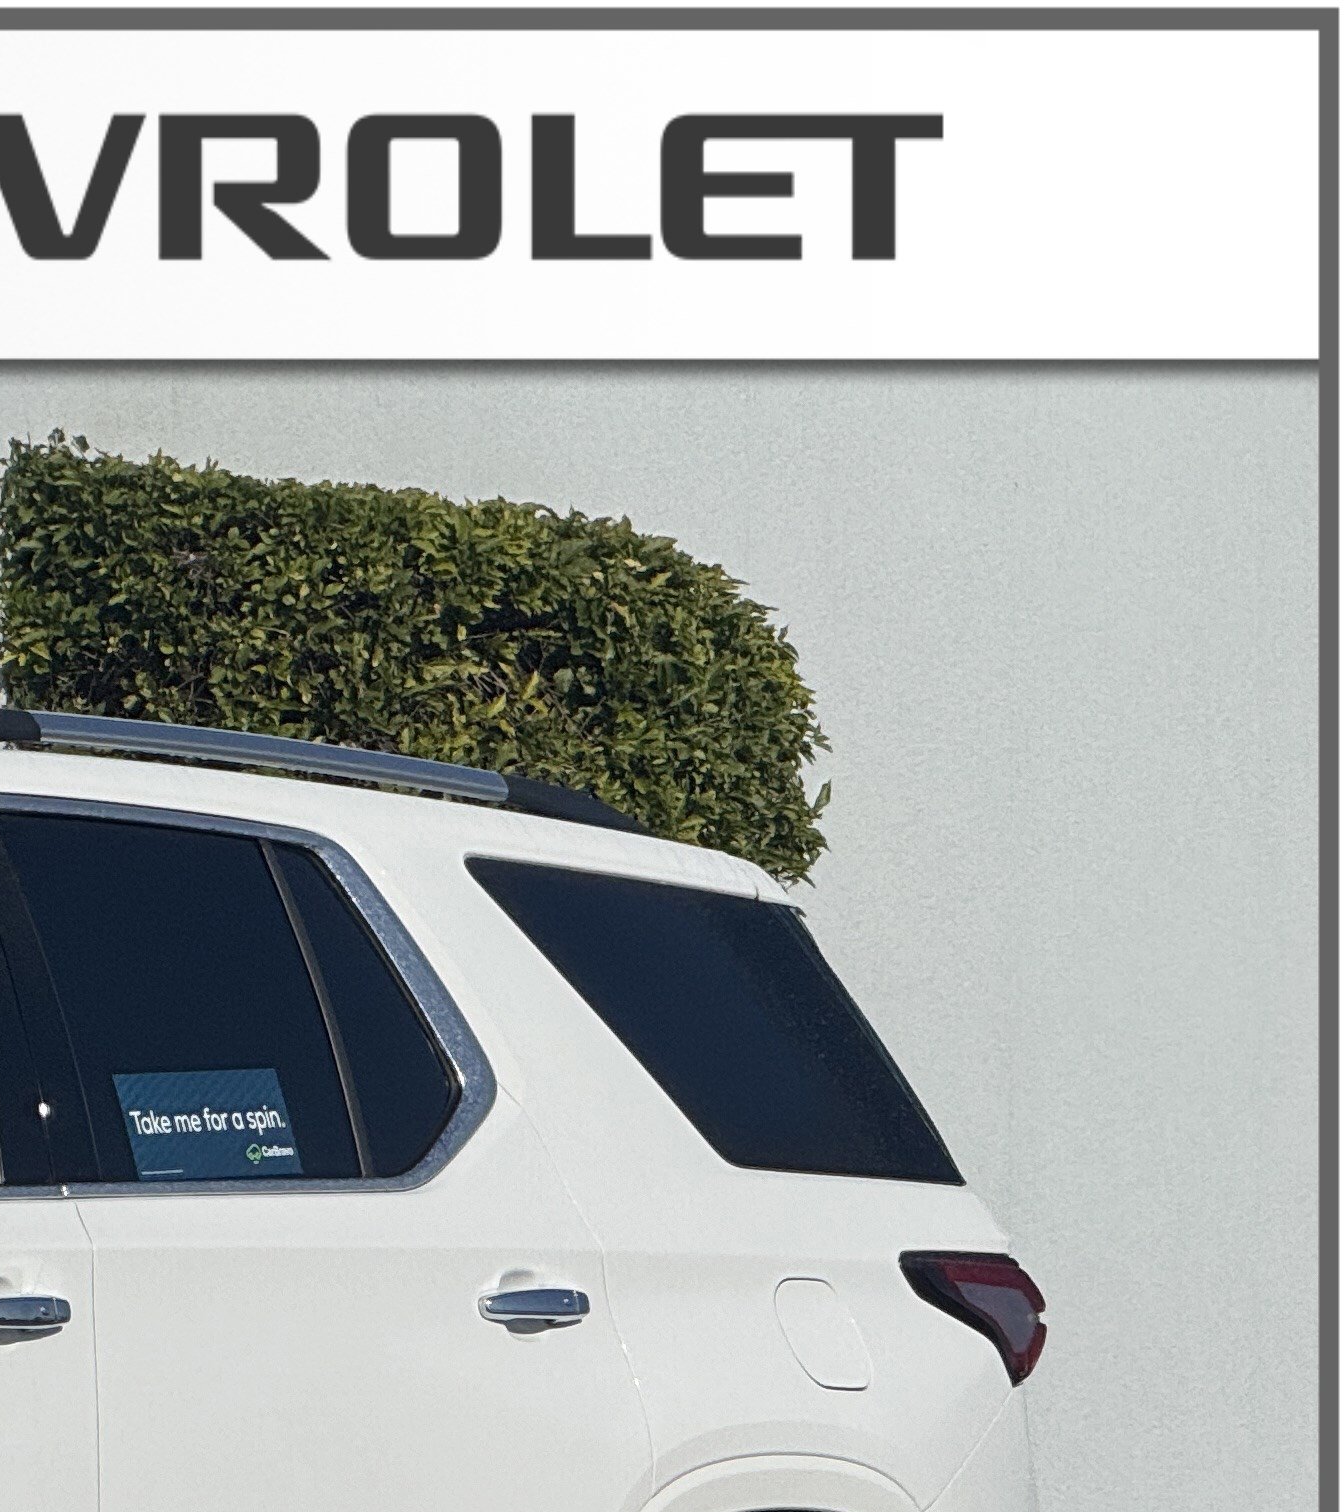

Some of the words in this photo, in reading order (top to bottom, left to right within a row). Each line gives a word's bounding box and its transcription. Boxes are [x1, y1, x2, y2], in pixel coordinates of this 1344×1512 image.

[129, 1110, 172, 1135] Take
[174, 1114, 202, 1133] me
[203, 1107, 228, 1132] for
[232, 1112, 245, 1131] a
[247, 1105, 286, 1135] spin.
